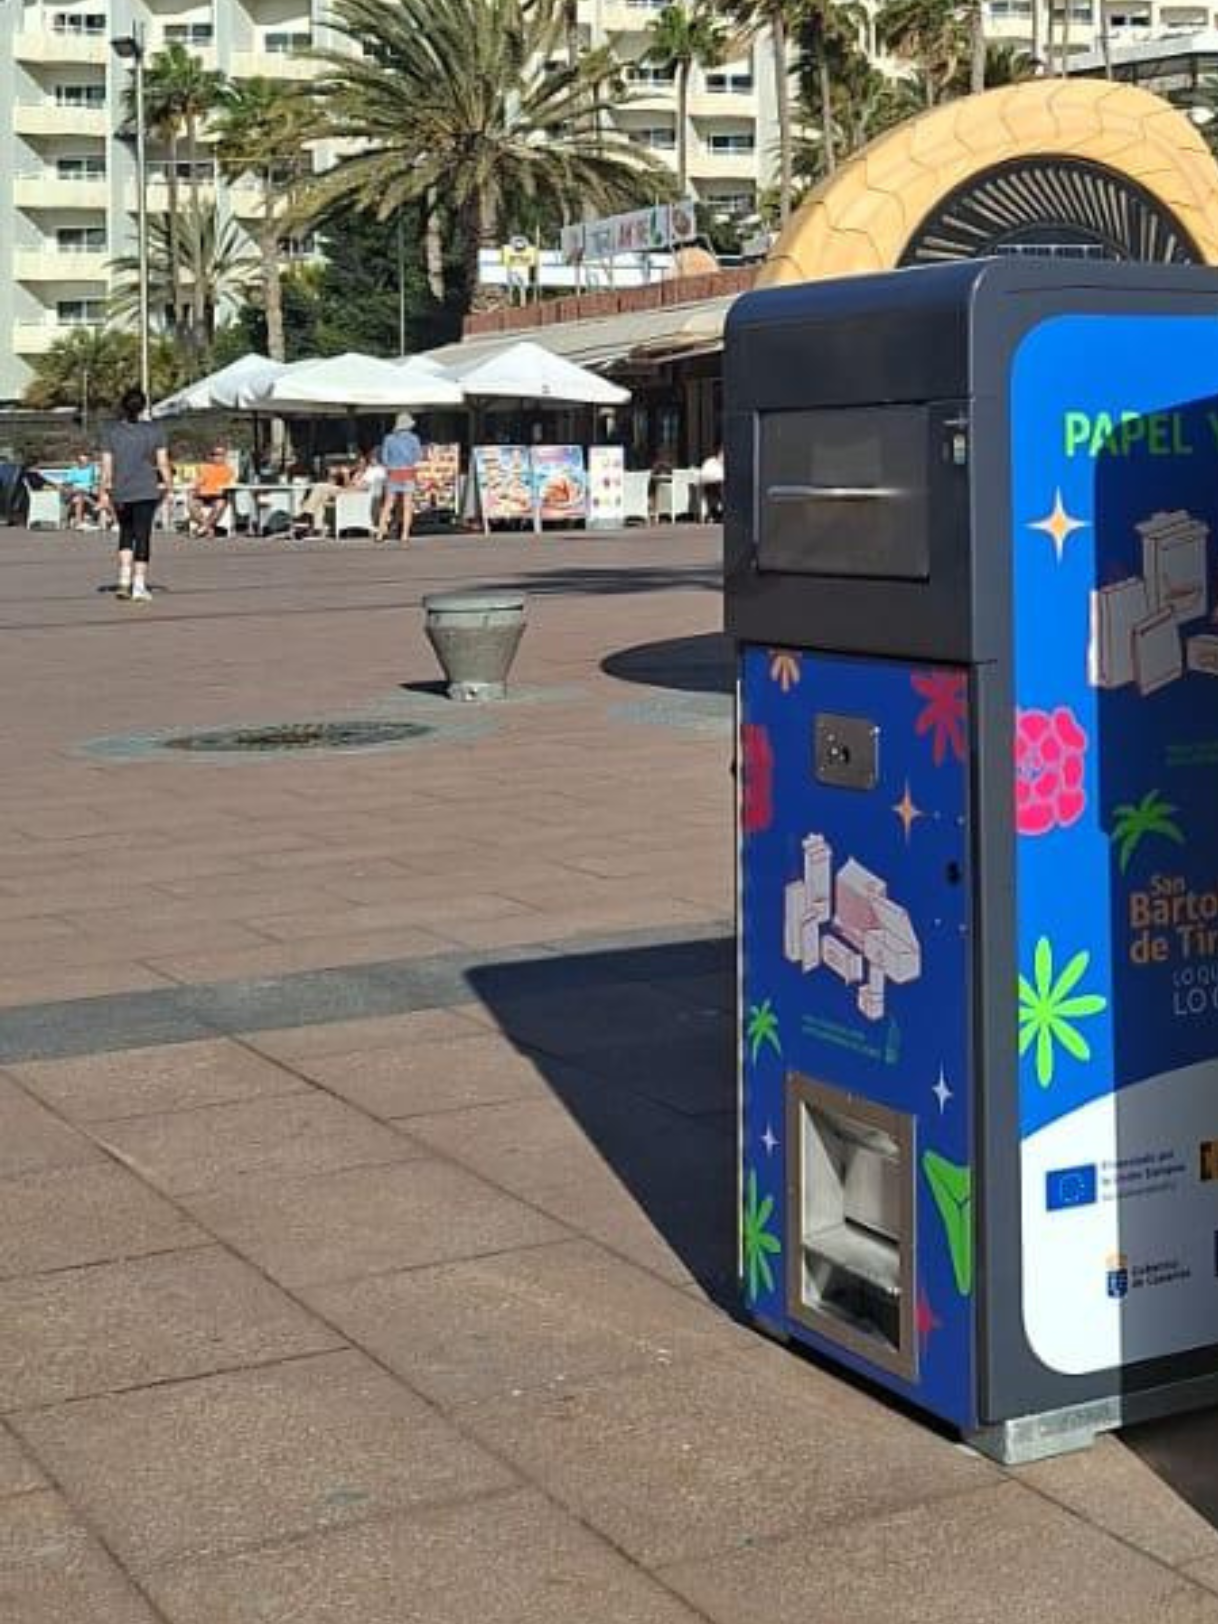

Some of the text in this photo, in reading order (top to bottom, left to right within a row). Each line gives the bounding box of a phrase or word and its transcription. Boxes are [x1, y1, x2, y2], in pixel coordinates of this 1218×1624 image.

[1063, 410, 1193, 457] PAPEL
[1150, 874, 1186, 898] San
[1129, 931, 1170, 965] de
